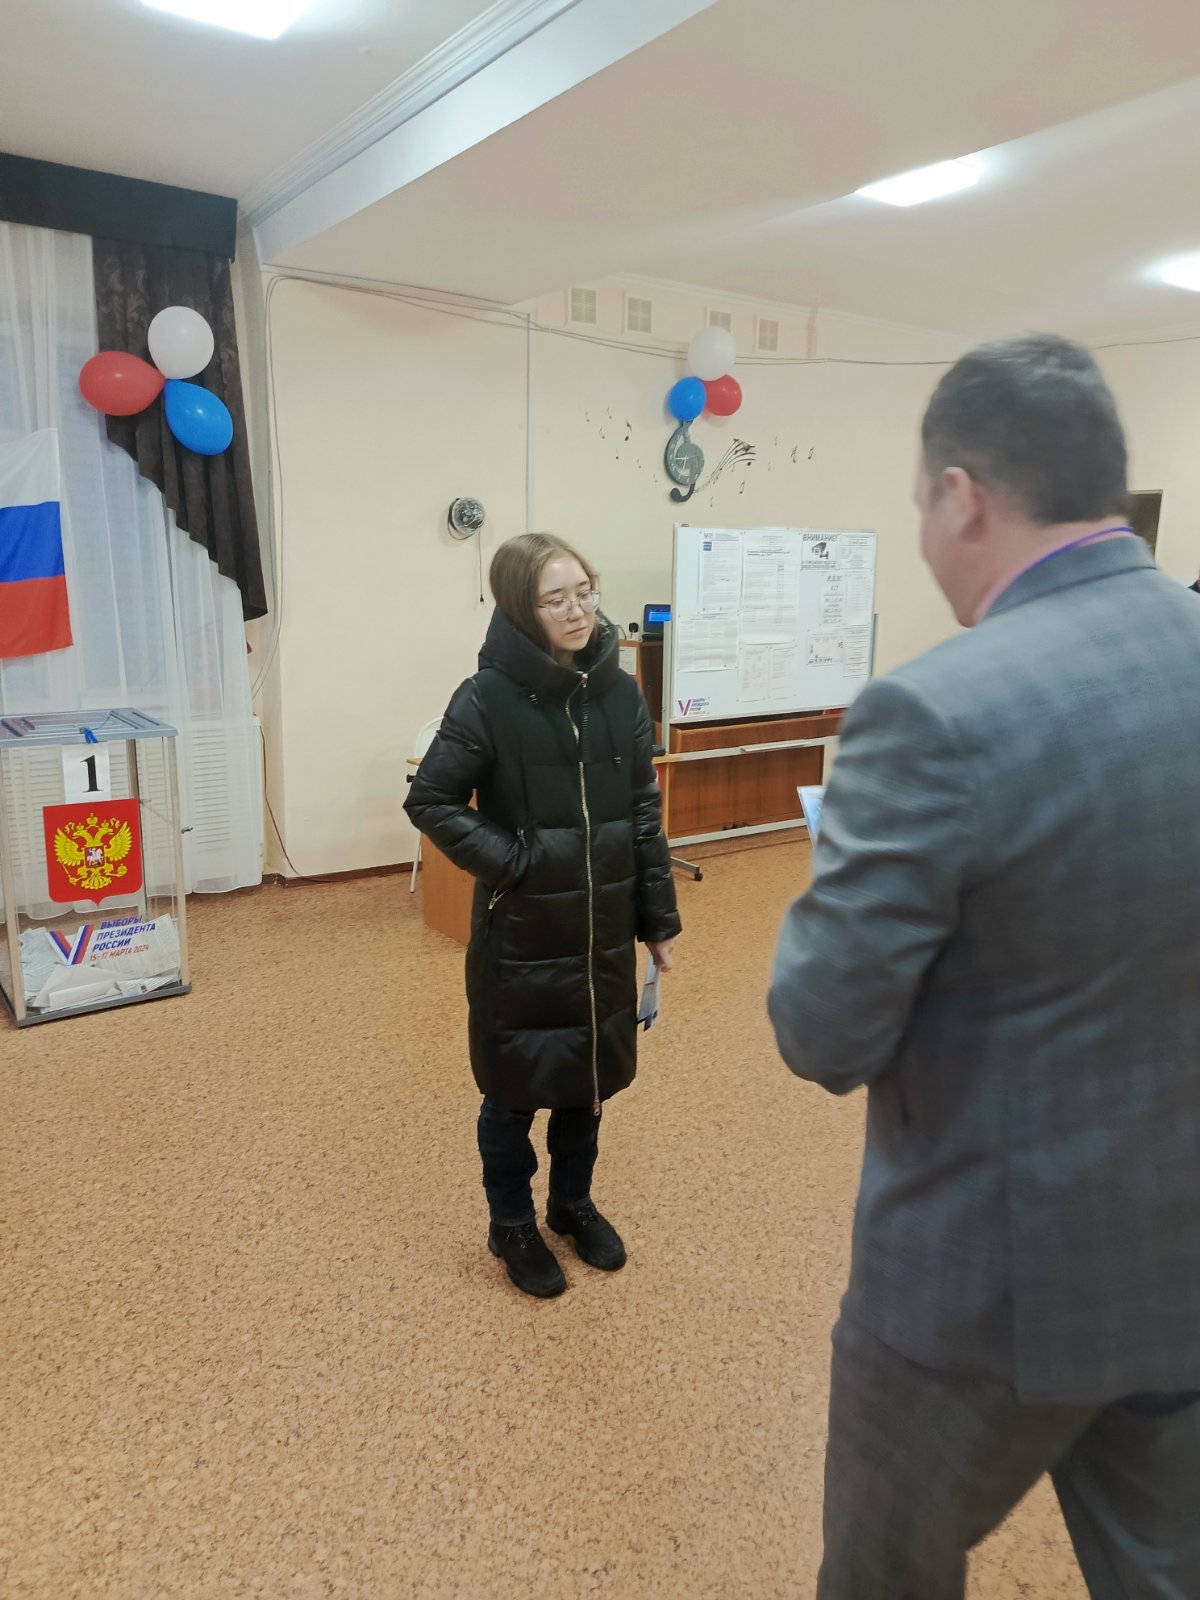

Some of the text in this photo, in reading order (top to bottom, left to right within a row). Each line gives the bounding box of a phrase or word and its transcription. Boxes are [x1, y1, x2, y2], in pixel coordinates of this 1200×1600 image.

[80, 755, 104, 793] 1
[100, 916, 143, 930] ВЫБОРЫ
[96, 923, 156, 941] ПРЕЗИДЕНТА
[92, 938, 131, 952] РОССИИ
[108, 948, 133, 958] МАРТА
[133, 944, 150, 953] 2024
